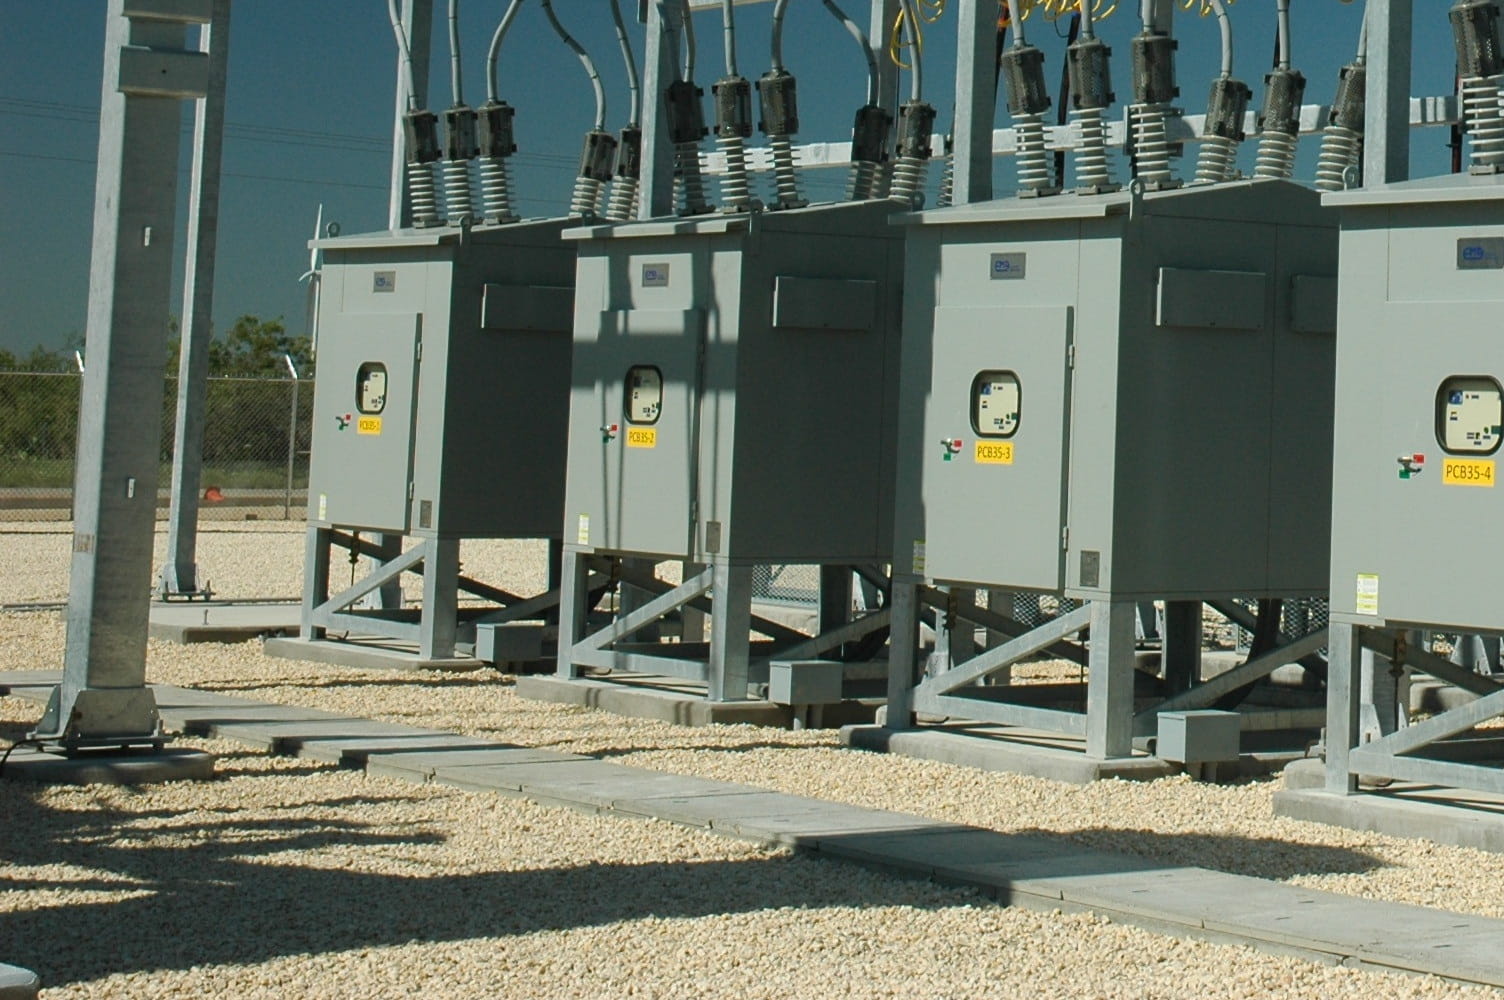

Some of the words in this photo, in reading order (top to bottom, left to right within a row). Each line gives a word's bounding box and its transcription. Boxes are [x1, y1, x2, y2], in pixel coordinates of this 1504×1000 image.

[629, 431, 654, 443] PCB35-2
[977, 447, 1010, 459] PCB35-3
[1446, 465, 1491, 480] PCB35-4
